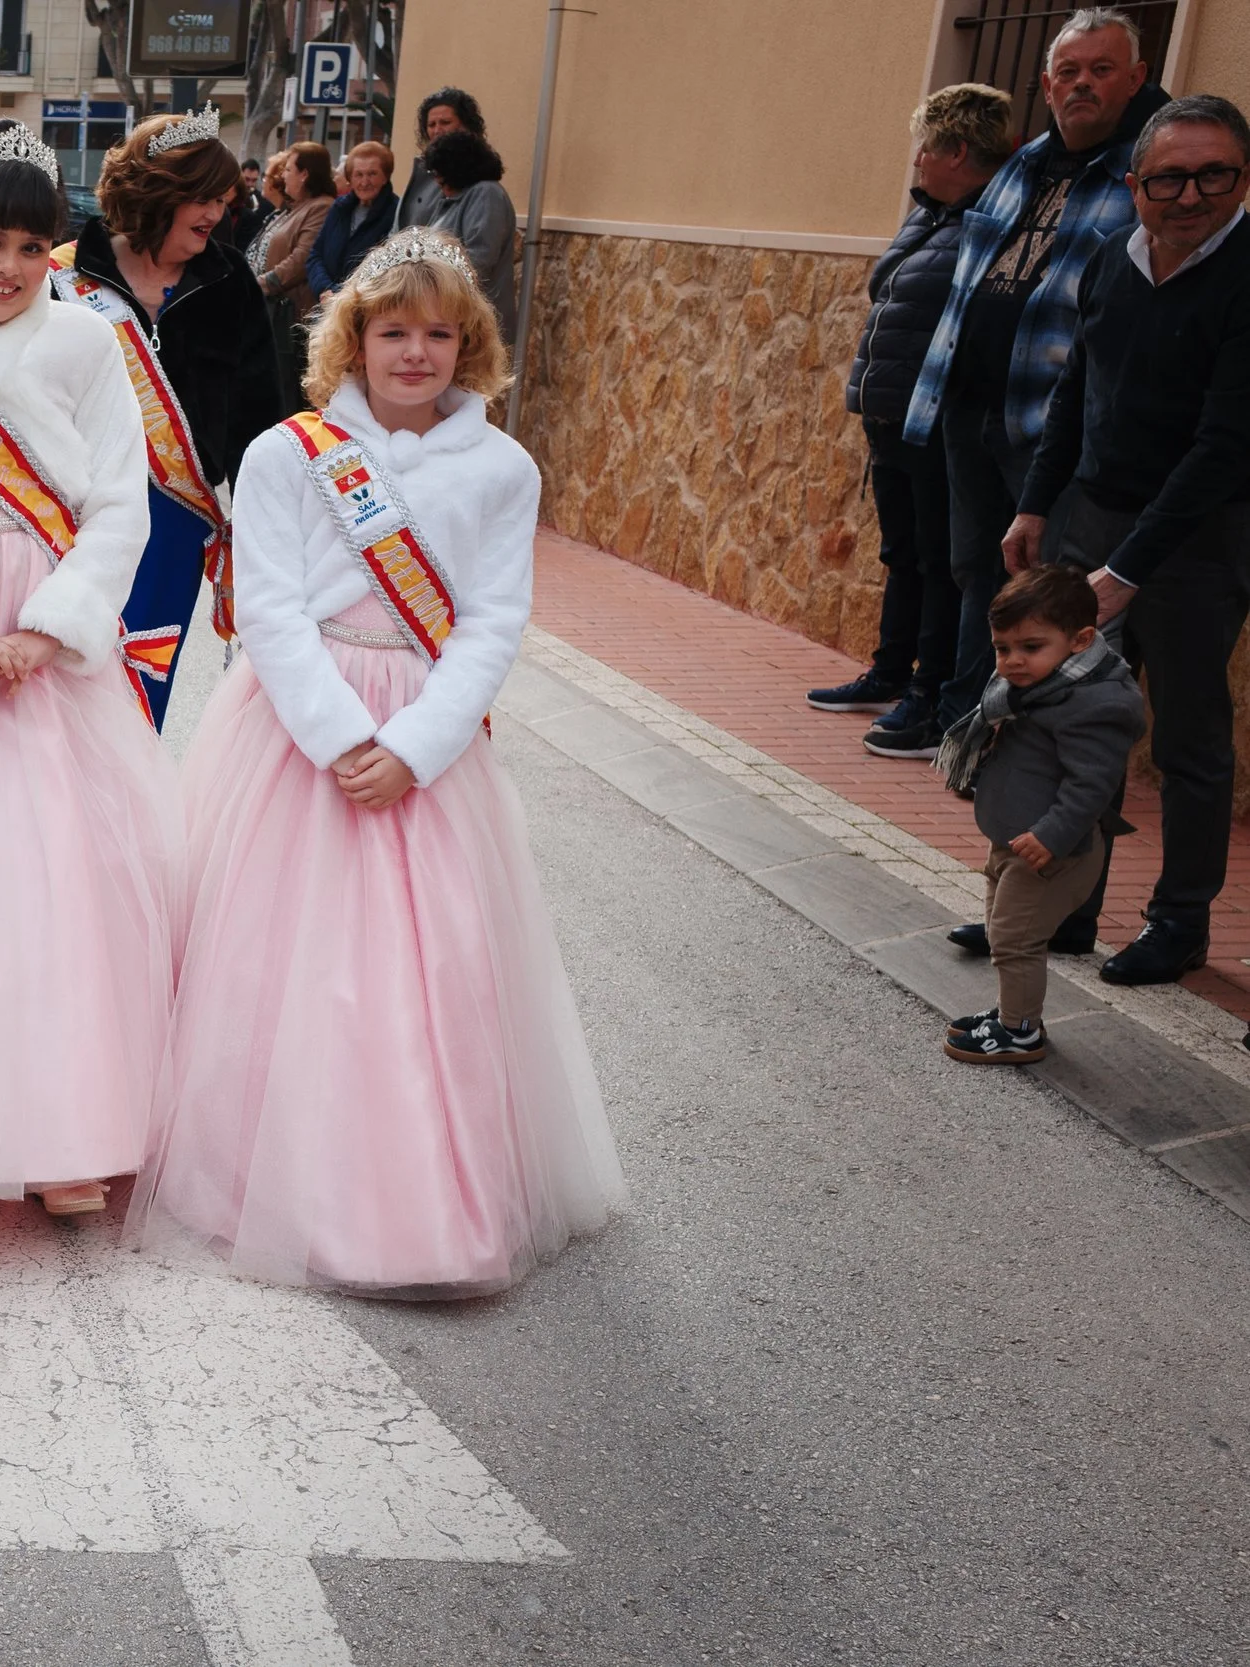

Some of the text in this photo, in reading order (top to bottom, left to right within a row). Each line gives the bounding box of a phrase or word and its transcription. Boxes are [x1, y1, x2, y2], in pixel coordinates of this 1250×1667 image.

[148, 35, 173, 53] 968
[311, 50, 342, 98] P
[357, 499, 376, 514] SAN
[374, 541, 450, 638] REINA
